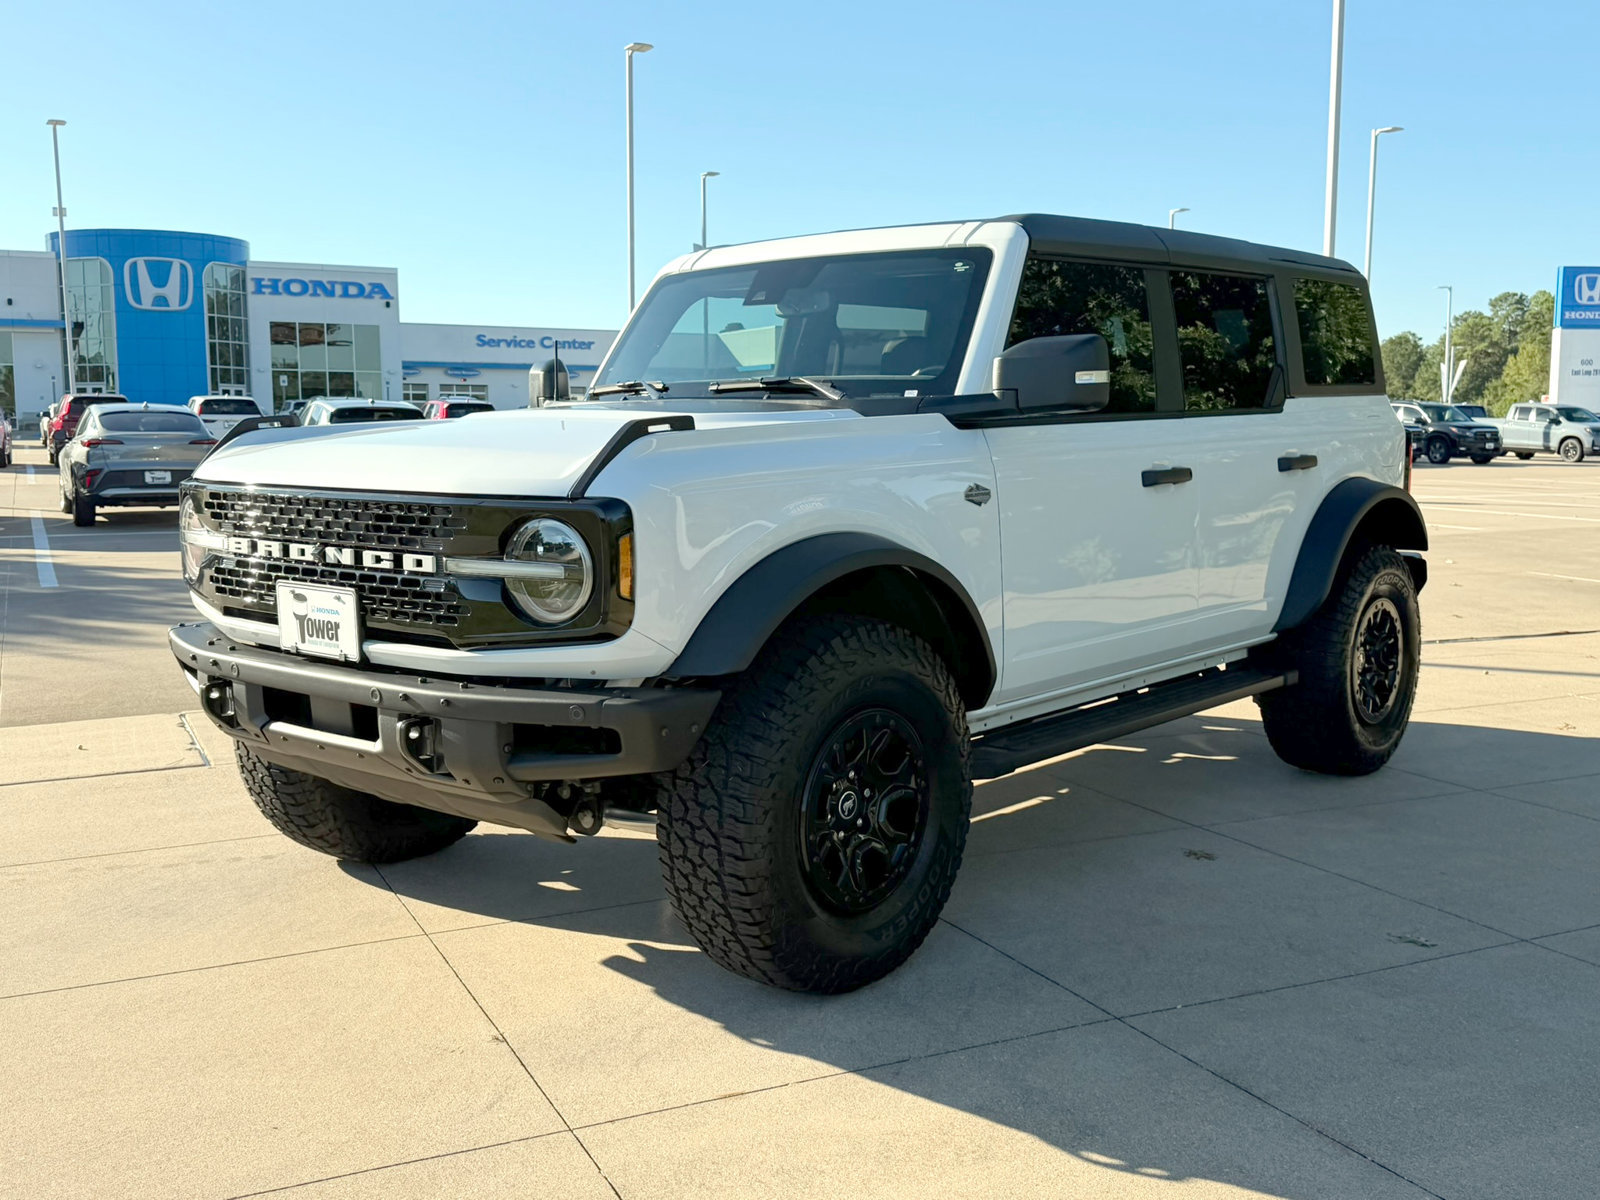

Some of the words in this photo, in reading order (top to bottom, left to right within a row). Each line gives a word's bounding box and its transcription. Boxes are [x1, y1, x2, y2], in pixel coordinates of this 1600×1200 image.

[250, 277, 395, 300] HONDA
[475, 334, 536, 349] Service
[1580, 358, 1594, 366] 600
[229, 536, 437, 573] BRONCO
[1375, 574, 1409, 597] COOPER
[316, 607, 340, 616] HONDA
[293, 611, 340, 644] Tower
[881, 843, 948, 941] COOPER
